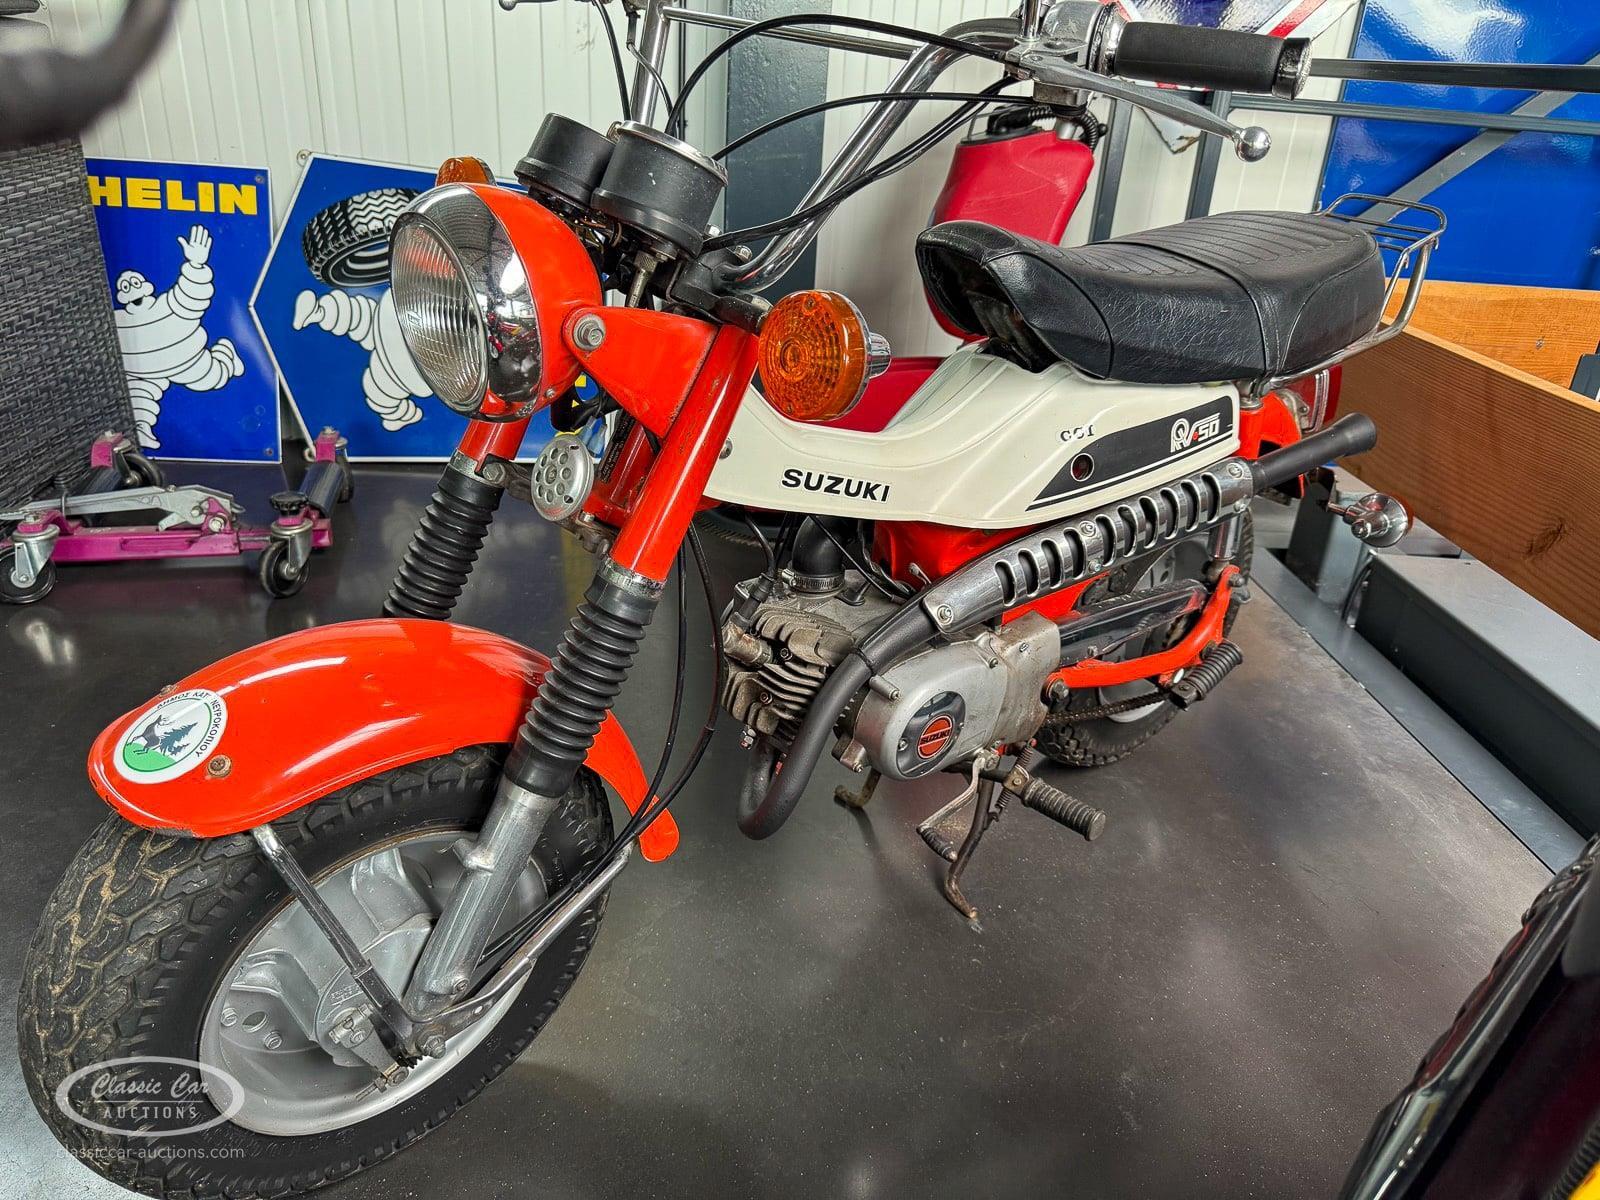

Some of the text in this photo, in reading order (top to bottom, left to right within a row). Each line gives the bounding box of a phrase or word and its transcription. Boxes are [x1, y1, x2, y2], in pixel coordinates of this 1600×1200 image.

[87, 175, 258, 216] HELIN
[781, 468, 890, 502] SUZUKI
[920, 729, 951, 743] SUZUKI
